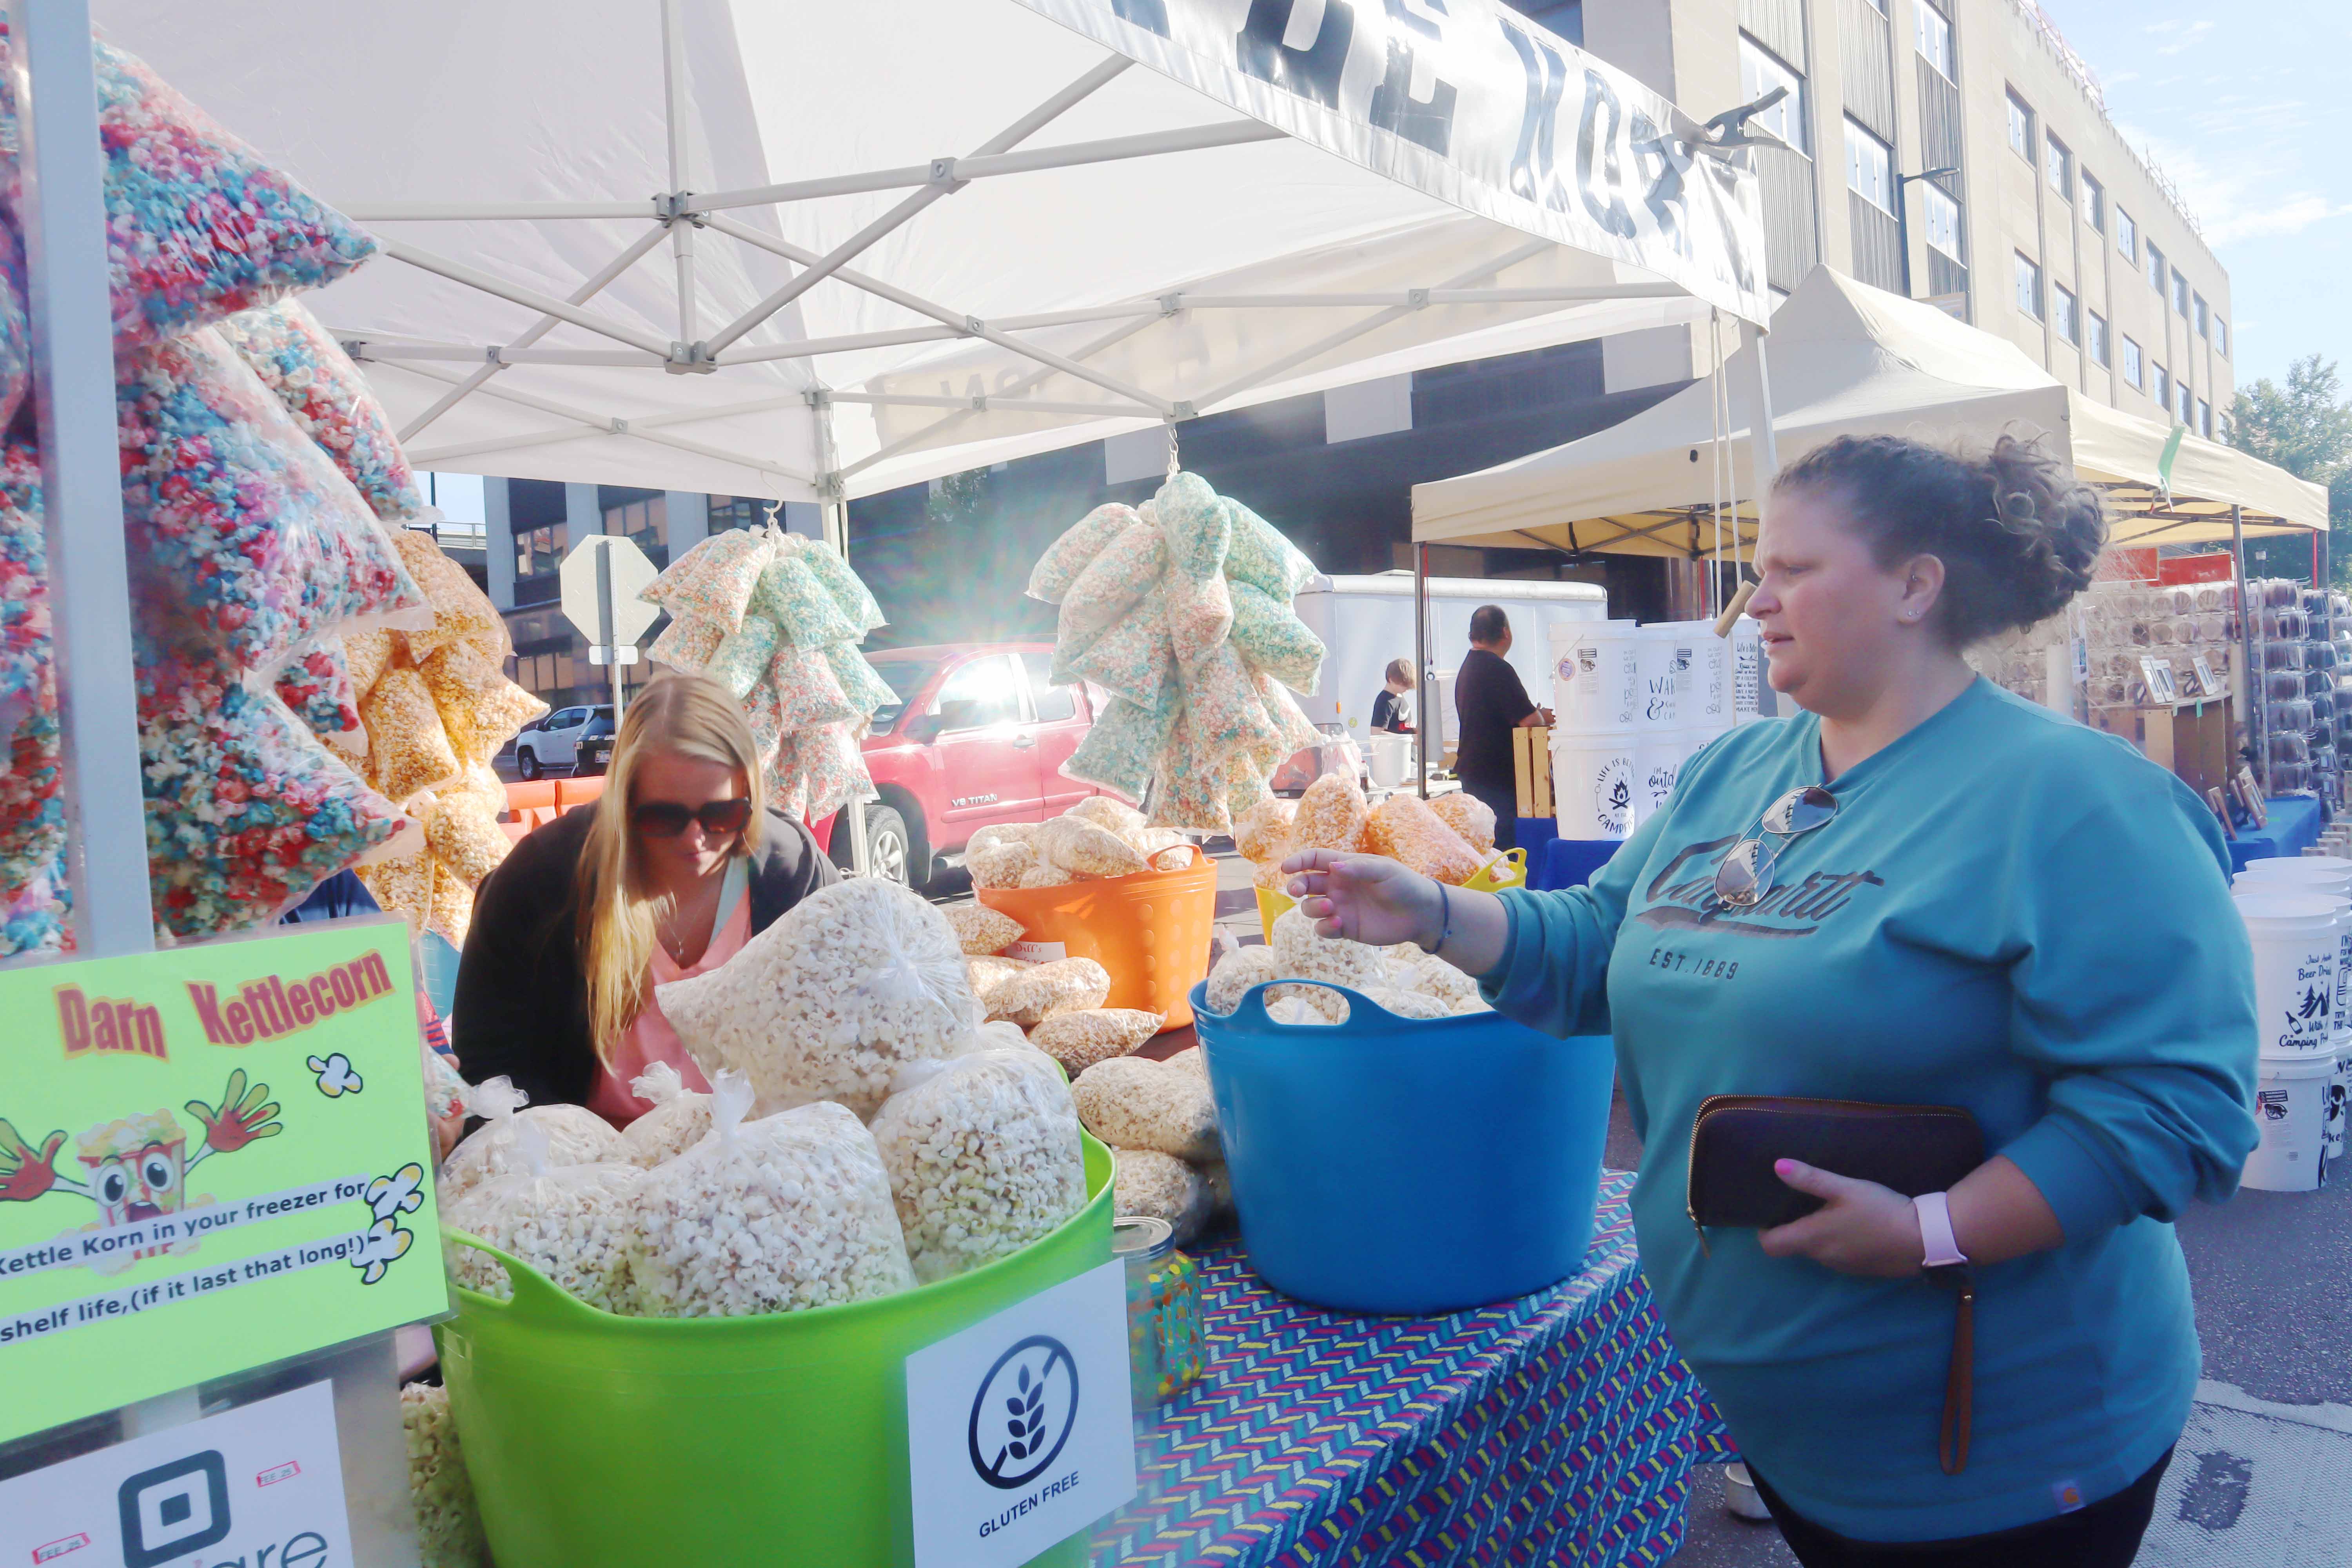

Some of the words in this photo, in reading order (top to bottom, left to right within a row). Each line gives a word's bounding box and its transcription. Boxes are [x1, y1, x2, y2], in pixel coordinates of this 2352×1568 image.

[1649, 677, 1675, 695] WAK
[1597, 764, 1611, 782] LIFE
[1612, 758, 1620, 767] IS
[1649, 764, 1677, 788] outd
[951, 798, 966, 806] V8
[968, 793, 998, 804] TITAN
[1016, 943, 1042, 953] Dill's
[2298, 968, 2316, 981] Beer
[54, 985, 169, 1062] Darn
[186, 950, 394, 1046] Kettlecorn
[2279, 1034, 2317, 1051] Camping
[83, 1231, 144, 1256] Korn
[153, 1223, 175, 1240] in
[185, 1210, 238, 1237] your
[246, 1191, 328, 1219] freezer
[334, 1182, 365, 1200] for
[0, 1308, 70, 1342] shelf
[168, 1281, 185, 1299] it
[193, 1268, 238, 1292] last
[244, 1254, 292, 1279] that
[299, 1235, 364, 1265] long!)
[979, 1493, 1038, 1538] GLUTEN
[1042, 1470, 1080, 1503] FREE
